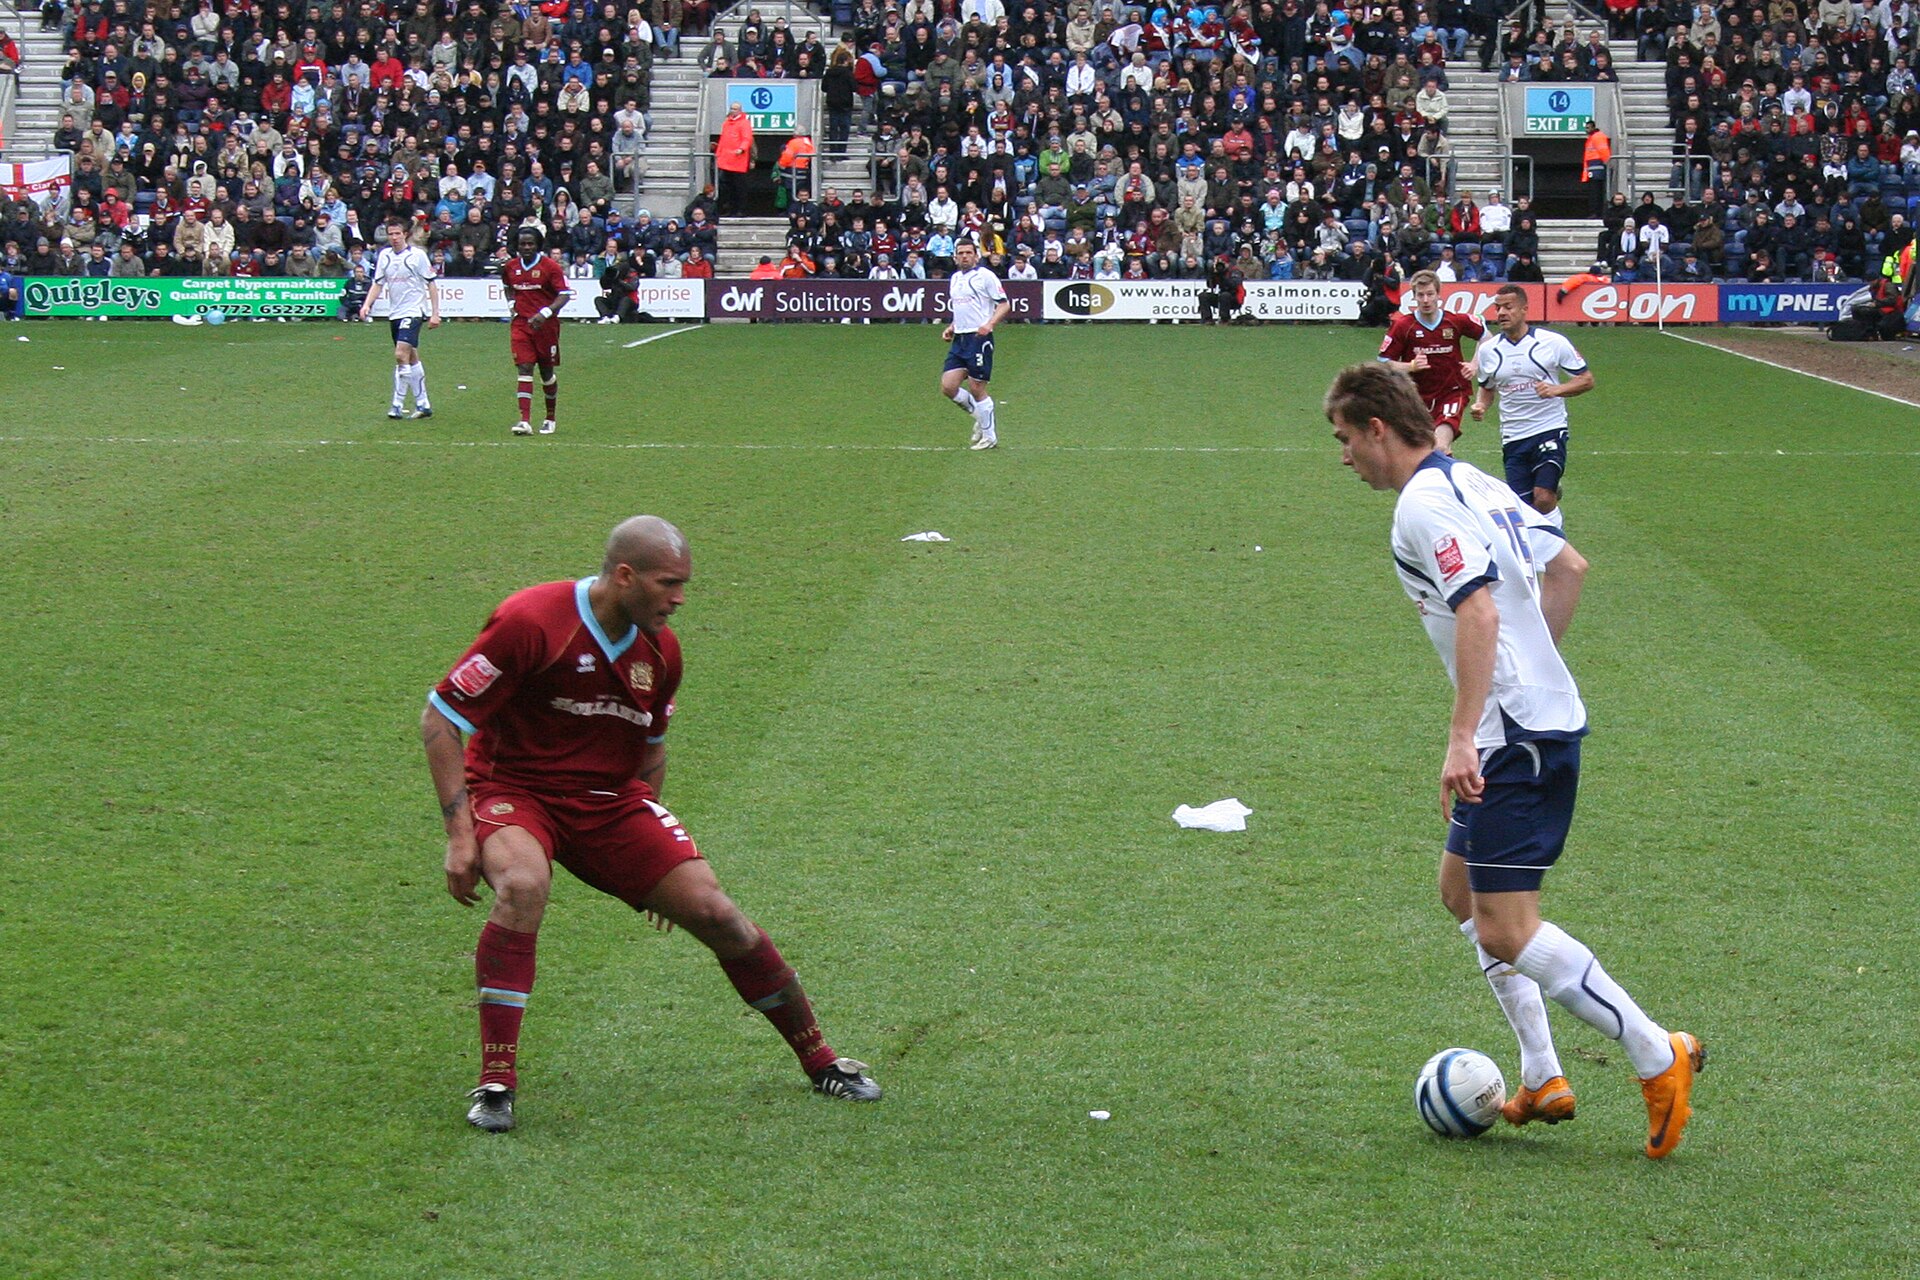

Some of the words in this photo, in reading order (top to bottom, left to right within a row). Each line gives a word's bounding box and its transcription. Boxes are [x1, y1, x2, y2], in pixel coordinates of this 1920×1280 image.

[753, 91, 771, 105] 13
[1551, 94, 1568, 108] 14
[746, 114, 764, 127] IT
[1527, 118, 1562, 131] EXIT
[182, 279, 230, 289] Carpet
[235, 279, 336, 290] Hypermarkets
[26, 279, 160, 311] Quigleys
[170, 291, 222, 301] Quality
[227, 291, 261, 300] Beds
[265, 291, 276, 300] &
[281, 291, 344, 300] Furnitur
[641, 285, 690, 304] rprise
[721, 286, 763, 312] dwf
[776, 292, 872, 312] Solicitors
[882, 287, 925, 312] dwf
[1068, 290, 1102, 307] hsa
[196, 304, 251, 315] 01772
[259, 304, 326, 316] 652275
[1258, 302, 1268, 315] &
[1275, 303, 1341, 315] auditors
[399, 318, 412, 329] 12
[976, 353, 984, 366] 3
[485, 1043, 516, 1053] BFC
